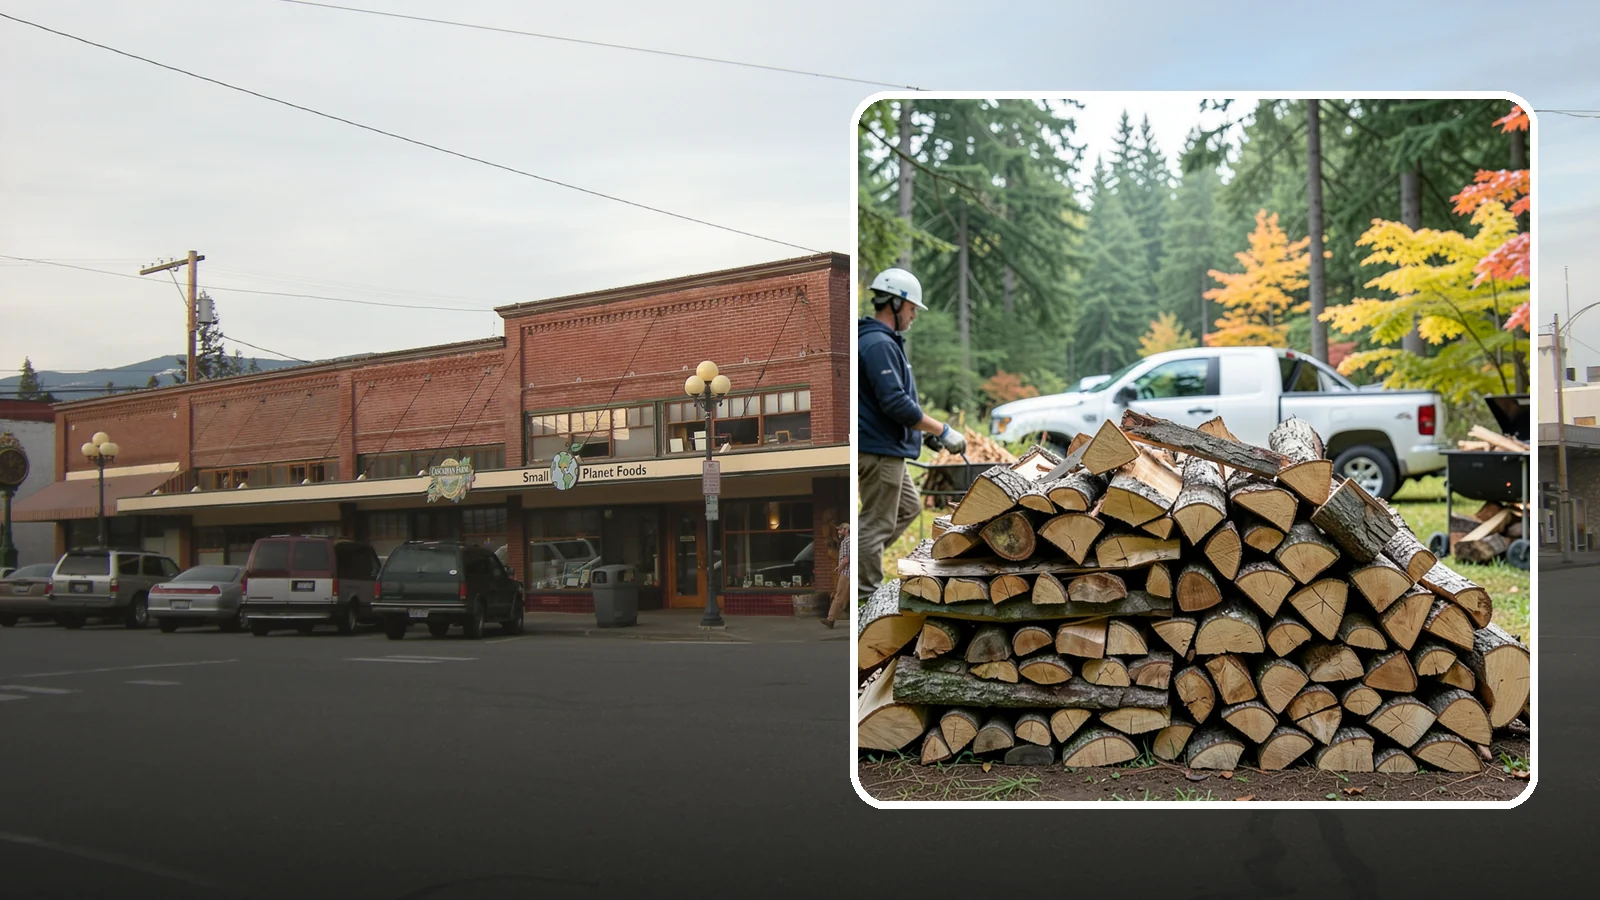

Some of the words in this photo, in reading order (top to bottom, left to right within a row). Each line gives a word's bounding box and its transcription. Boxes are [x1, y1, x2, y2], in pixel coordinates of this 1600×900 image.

[523, 471, 549, 483] Small
[583, 468, 614, 479] Planet
[617, 464, 647, 477] Foods
